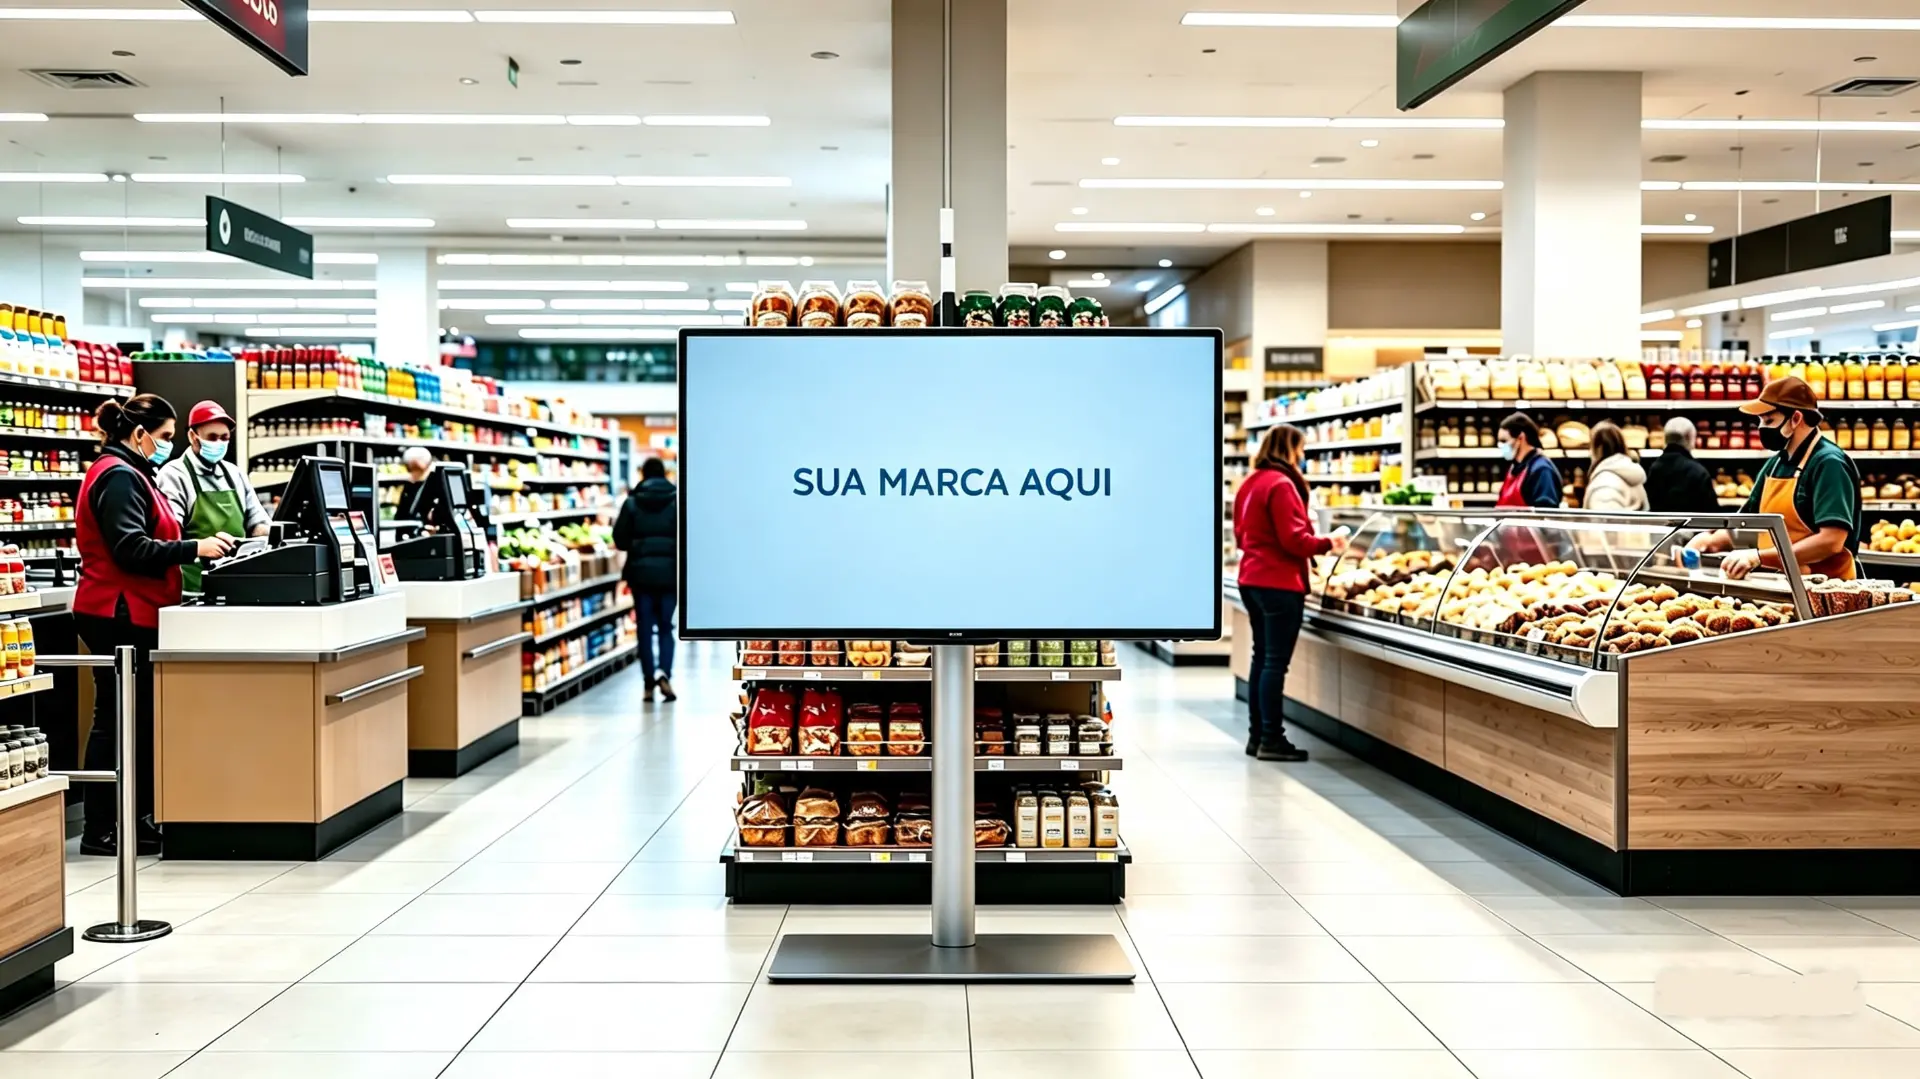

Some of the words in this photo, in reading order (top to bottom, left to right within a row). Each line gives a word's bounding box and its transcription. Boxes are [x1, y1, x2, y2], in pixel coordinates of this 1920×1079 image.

[792, 467, 867, 497] SUA
[879, 467, 1010, 497] MARCA
[1019, 467, 1112, 502] AQUI
